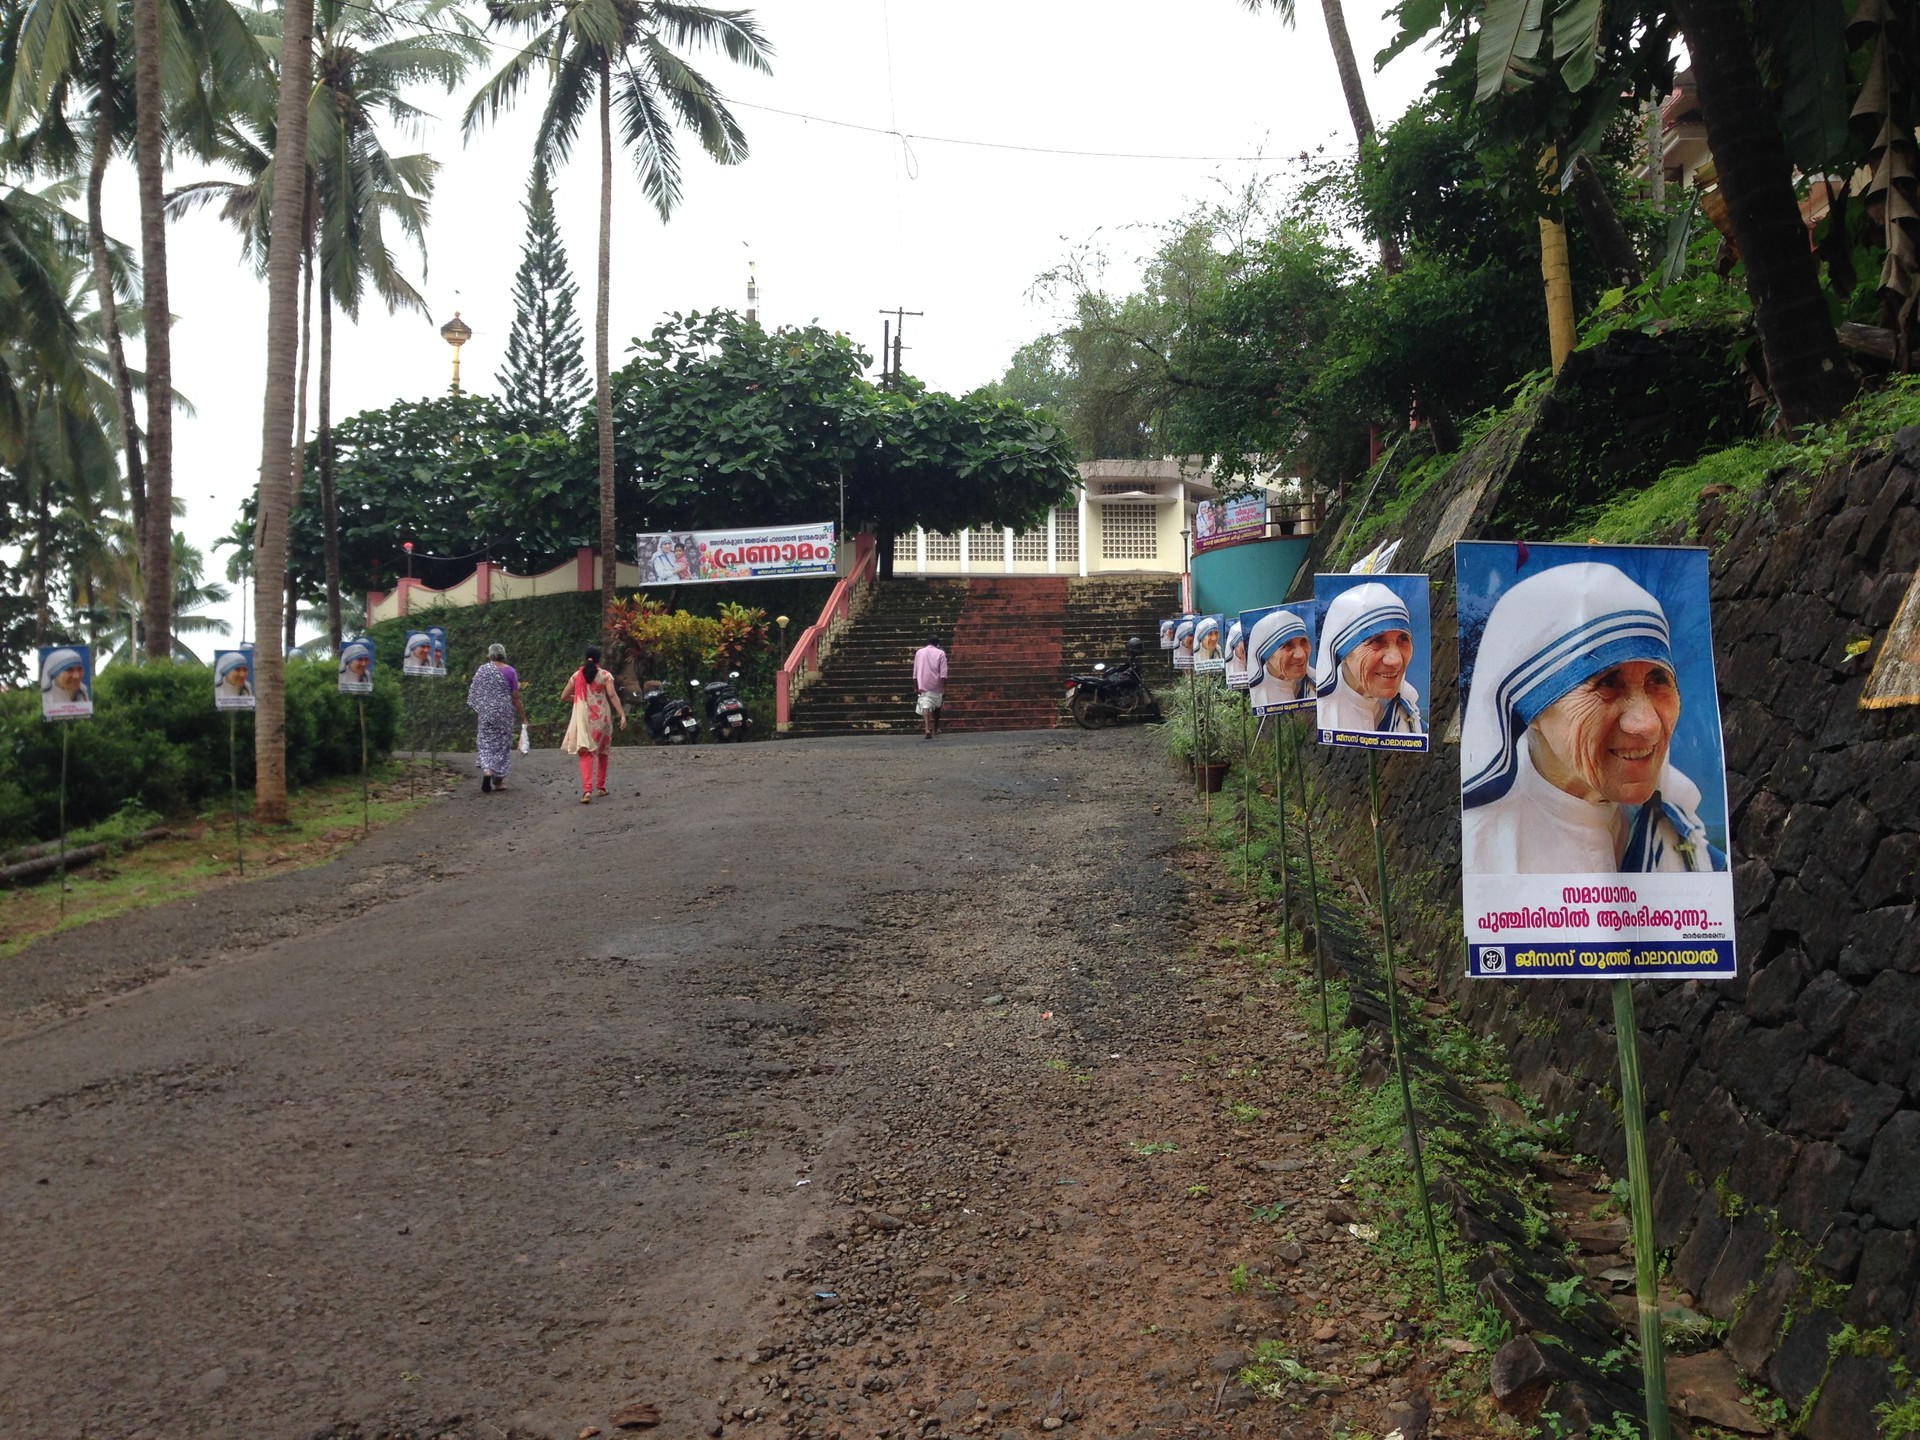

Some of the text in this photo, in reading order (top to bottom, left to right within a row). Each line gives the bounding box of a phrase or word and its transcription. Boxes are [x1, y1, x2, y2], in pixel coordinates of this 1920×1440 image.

[713, 543, 830, 568] പ്രണാമം
[1336, 733, 1423, 748] ജീസസ് യൂത്ത് പാലാവയൽ
[1562, 886, 1637, 905] സമാധാനം
[1477, 905, 1723, 934] പുഞ്ചിരിയിൽ ആരംഭിക്കുന്നു...
[1514, 948, 1718, 970] ജീസസ് യൂത്ത് പാലാവയൽ
